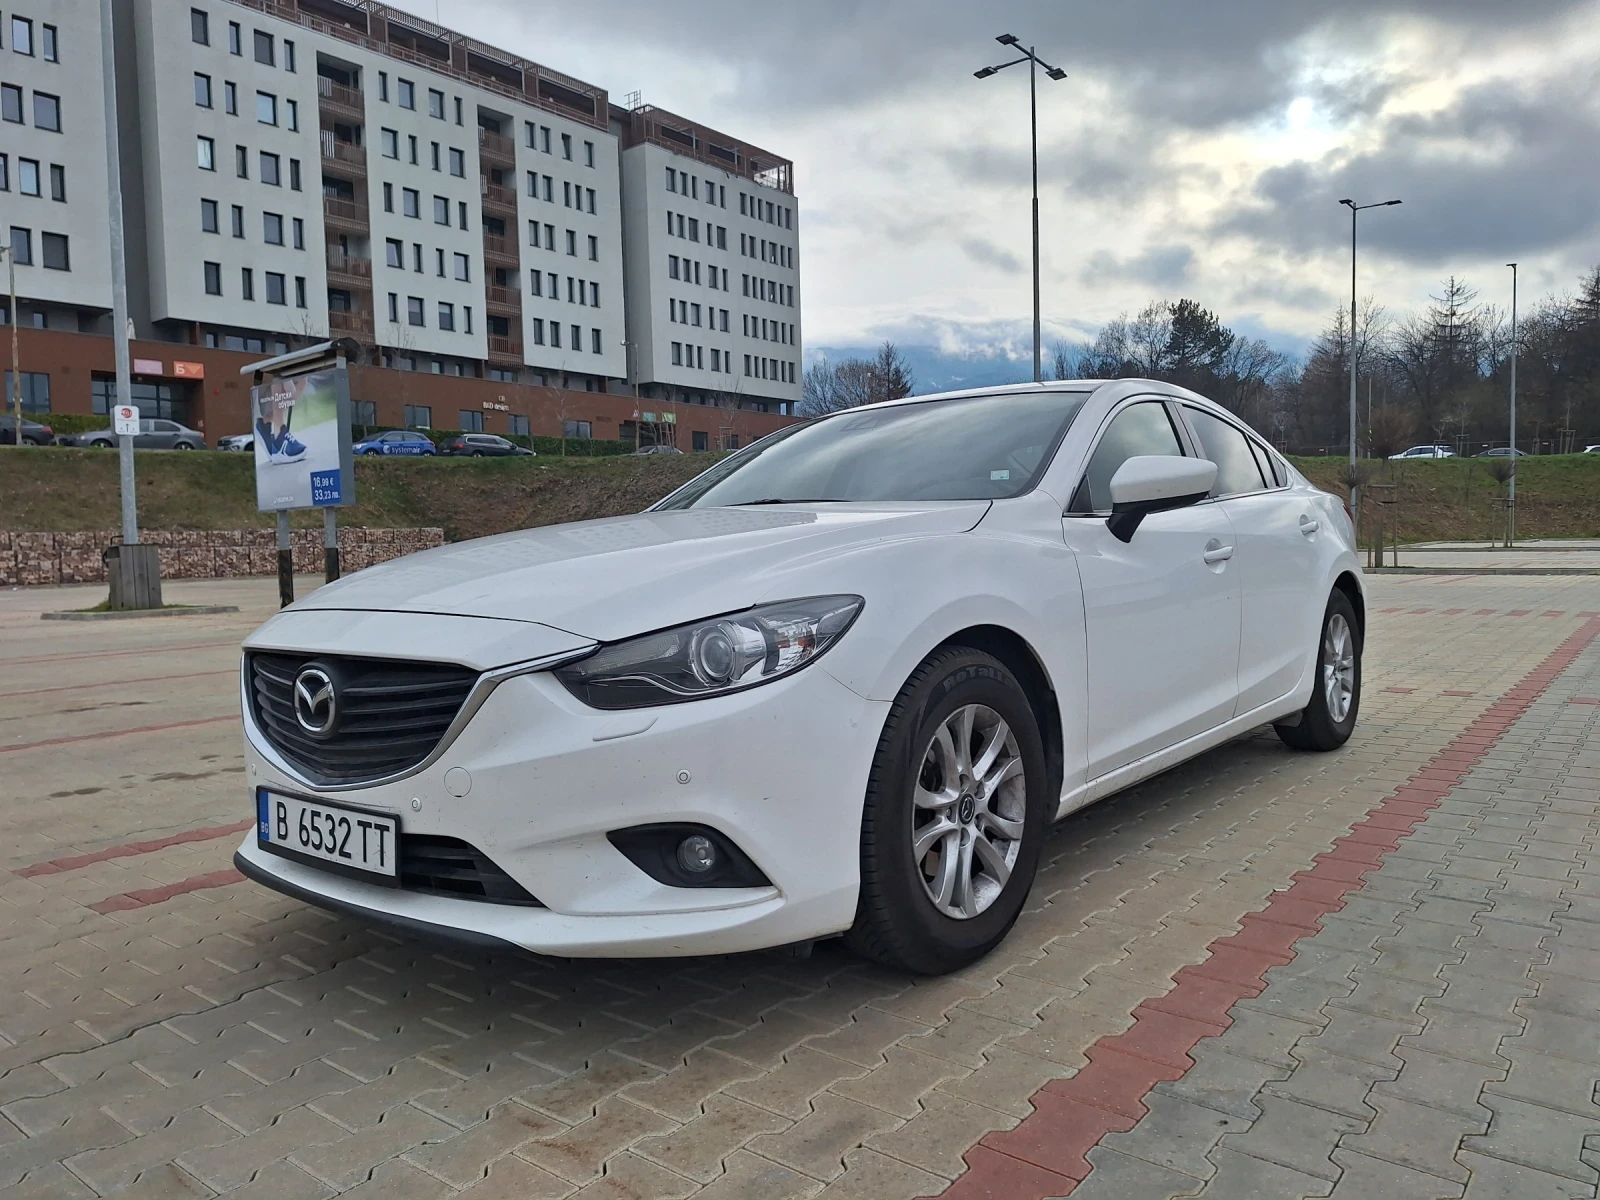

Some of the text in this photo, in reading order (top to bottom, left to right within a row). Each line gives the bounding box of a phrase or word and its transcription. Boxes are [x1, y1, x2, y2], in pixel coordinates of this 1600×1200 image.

[391, 446, 421, 454] systemair
[276, 801, 288, 840] B
[261, 821, 269, 834] BG
